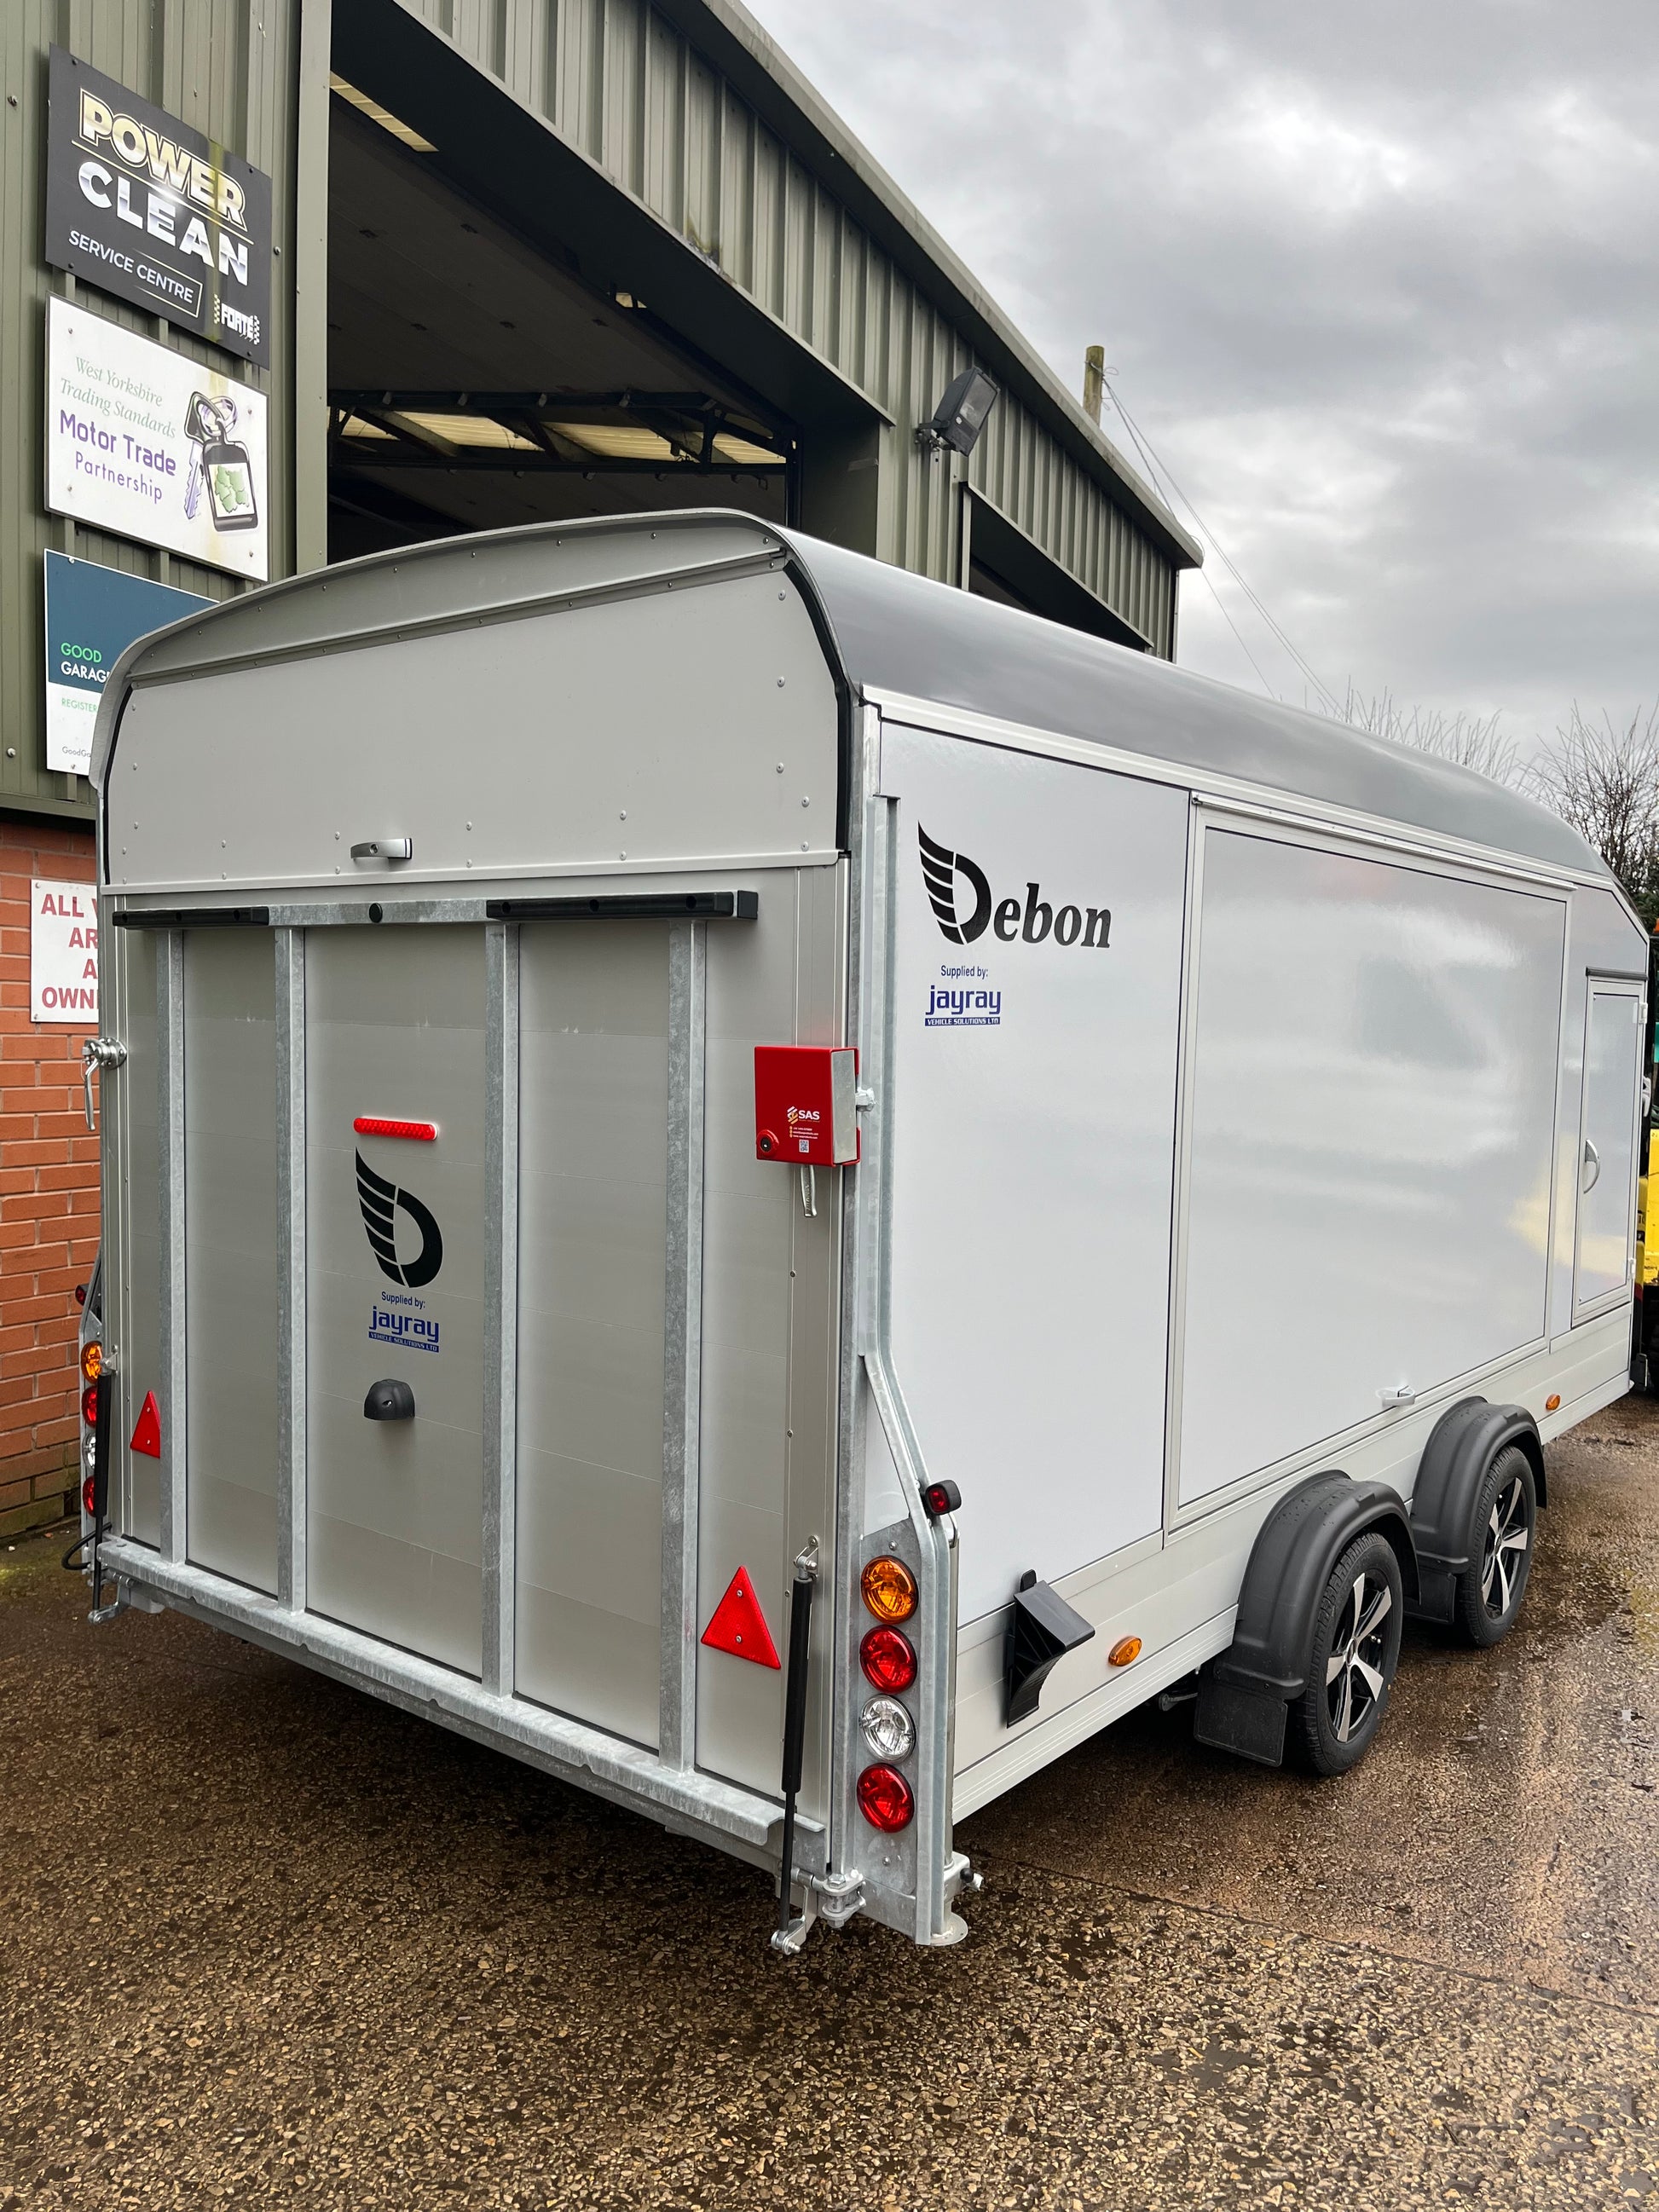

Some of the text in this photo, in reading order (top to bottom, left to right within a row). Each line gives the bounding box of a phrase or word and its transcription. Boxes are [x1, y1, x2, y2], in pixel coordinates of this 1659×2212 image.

[79, 88, 248, 232] POWER
[78, 161, 248, 286] CLEAN
[68, 230, 194, 303] SERVICE CENTRE
[75, 356, 163, 407] West Yorkshire
[61, 378, 176, 439] Trading Standards
[60, 409, 176, 476] Motor Trade
[75, 450, 163, 505] Partnership
[61, 642, 102, 663] GOOD
[917, 819, 1112, 949] Debon
[41, 893, 84, 918] ALL
[940, 964, 989, 980] Supplied by:
[42, 986, 99, 1010] OWN
[925, 985, 1002, 1015] jayray
[798, 1110, 820, 1120] SAS
[381, 1291, 426, 1310] Supplied by:
[368, 1306, 439, 1343] jayray
[370, 1332, 392, 1343] VEHICLE
[393, 1337, 425, 1349] SOLUTIONS
